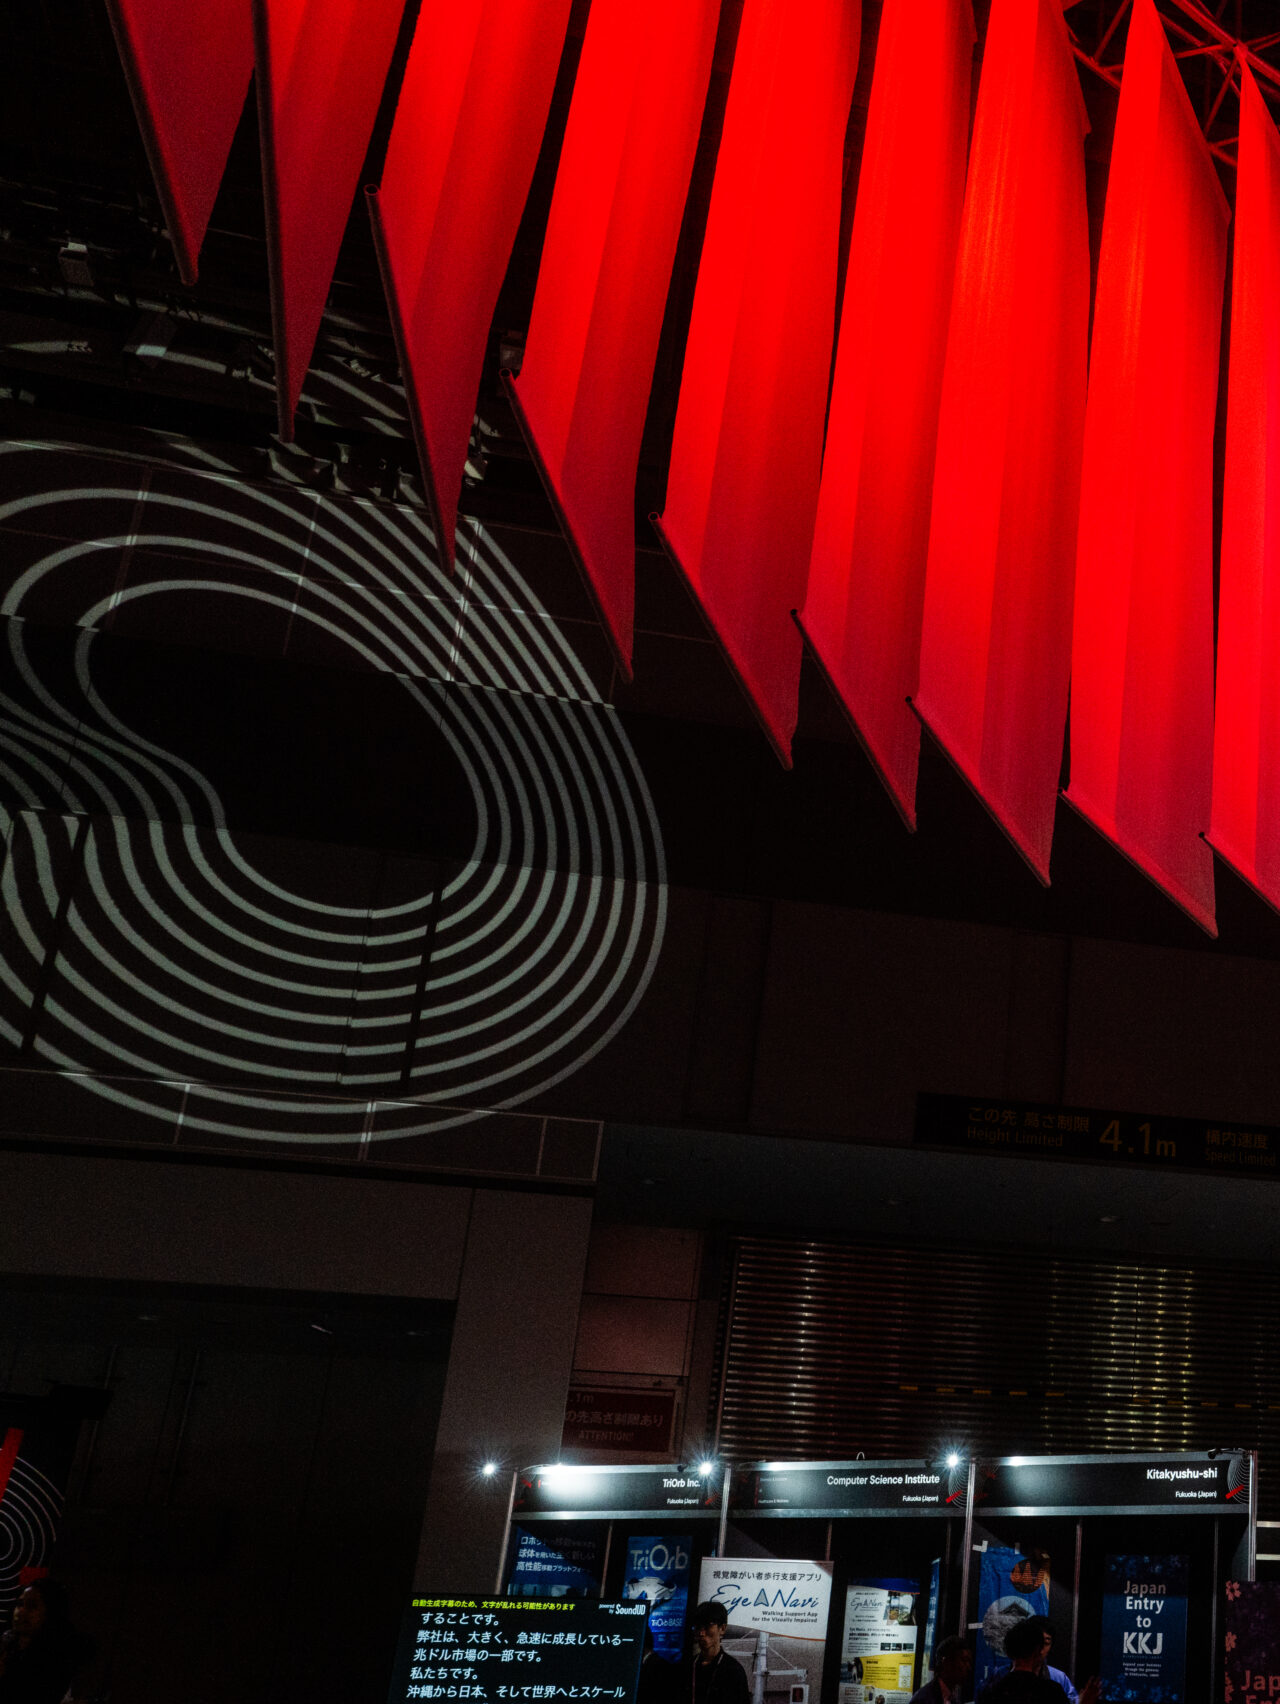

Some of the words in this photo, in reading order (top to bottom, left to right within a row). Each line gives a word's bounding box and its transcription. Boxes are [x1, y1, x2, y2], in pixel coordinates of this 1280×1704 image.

[967, 1125, 1011, 1145] Height
[1015, 1128, 1064, 1148] Limited
[827, 1475, 868, 1487] Computer
[869, 1475, 903, 1486] Science
[904, 1474, 941, 1485] Institute
[1146, 1467, 1219, 1482] Kitakyushu-shi
[662, 1478, 686, 1489] TriOrb
[687, 1478, 701, 1488] Inc.
[902, 1494, 922, 1503] Fukuoka
[922, 1494, 939, 1503] (Japan)
[1175, 1489, 1198, 1499] Fukuoka
[1198, 1489, 1218, 1499] (Japan)
[630, 1543, 690, 1572] TriOrb
[712, 1569, 823, 1583] 視覚障がい者歩行支援アプリ
[1123, 1580, 1167, 1598] Japan
[411, 1598, 577, 1612] 自動生成字幕のため、文字が乱れる可能性があります
[615, 1603, 647, 1616] SoundUD
[1125, 1595, 1164, 1614] Entry
[420, 1612, 502, 1627] することです。
[784, 1610, 806, 1618] Support
[1136, 1614, 1152, 1628] to
[1122, 1631, 1164, 1655] KKJ
[412, 1648, 544, 1663] 兆ドル市場の一部です。
[409, 1666, 480, 1681] 私たちです。
[405, 1684, 627, 1700] 沖縄から日本、そして世界へとスケール
